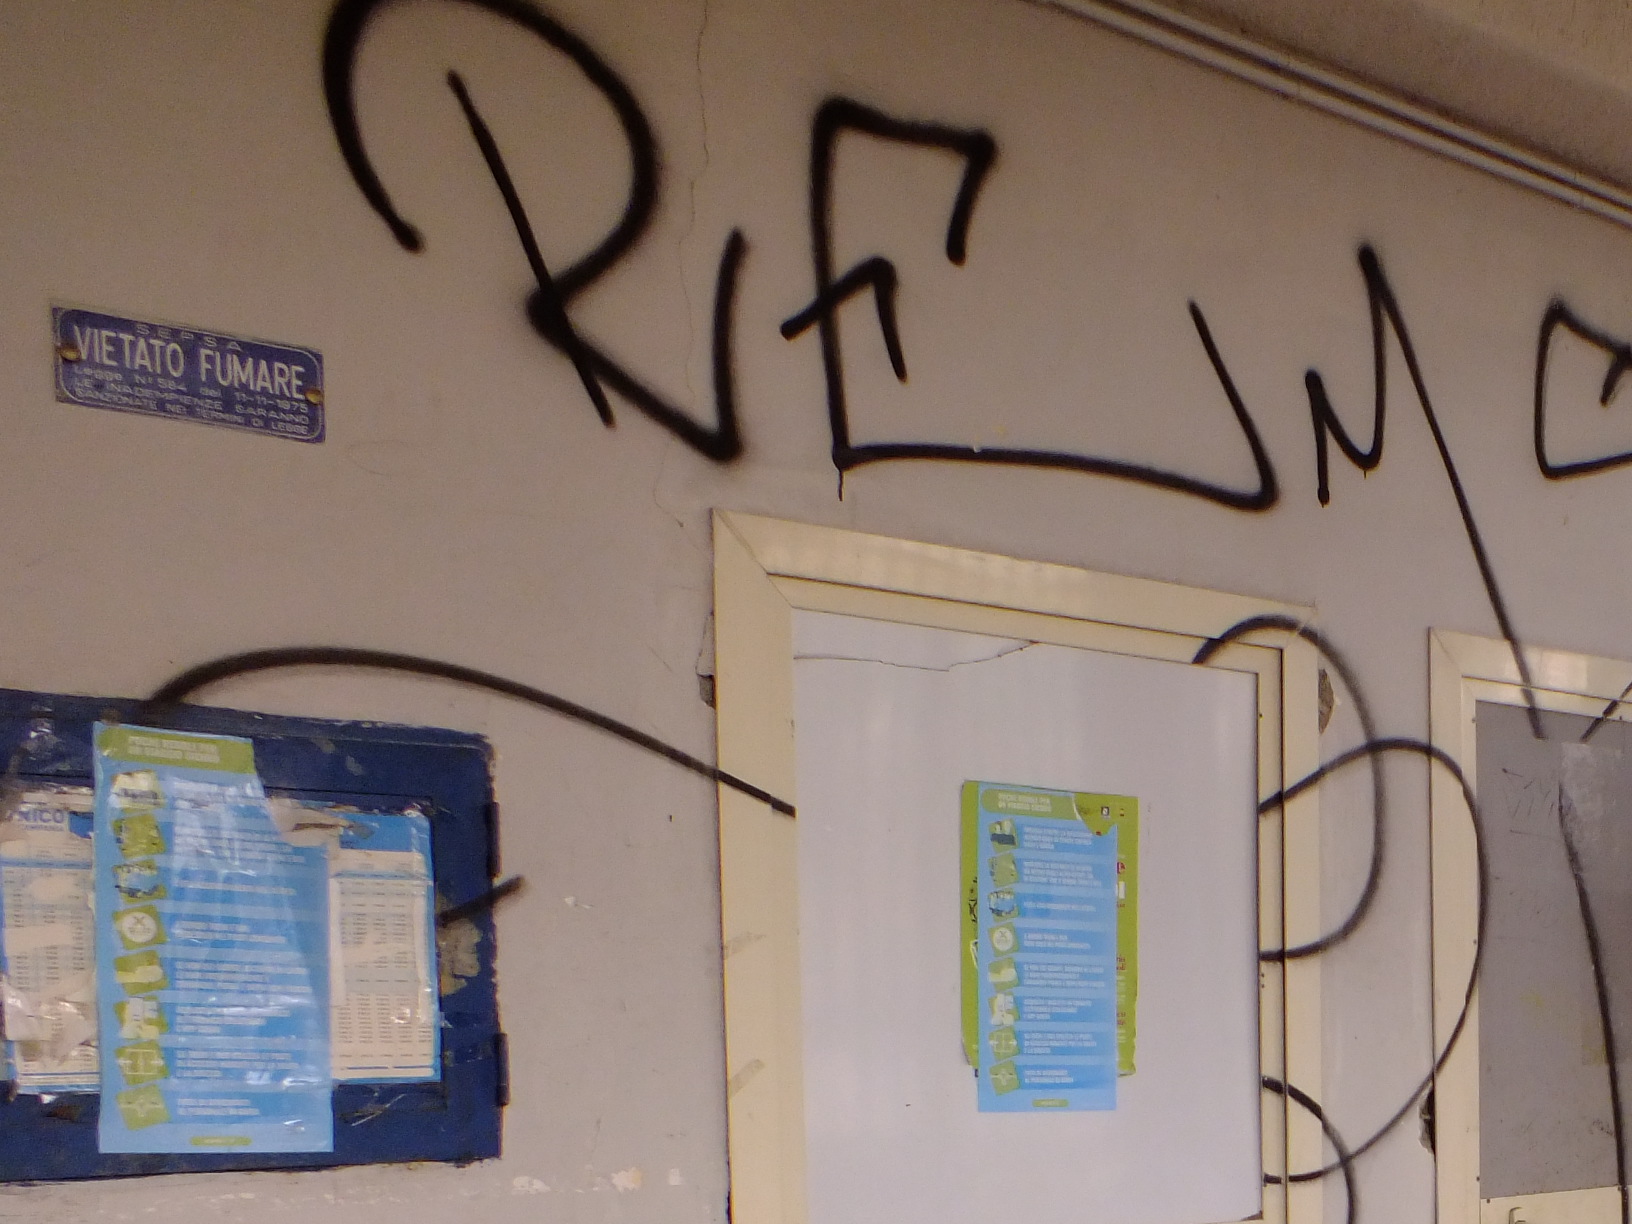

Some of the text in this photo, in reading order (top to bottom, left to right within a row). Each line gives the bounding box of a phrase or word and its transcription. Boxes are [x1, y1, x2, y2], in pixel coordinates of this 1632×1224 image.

[73, 324, 306, 401] VIETATO FUMARE
[235, 403, 310, 425] SARANNO
[271, 421, 310, 436] LEGGE
